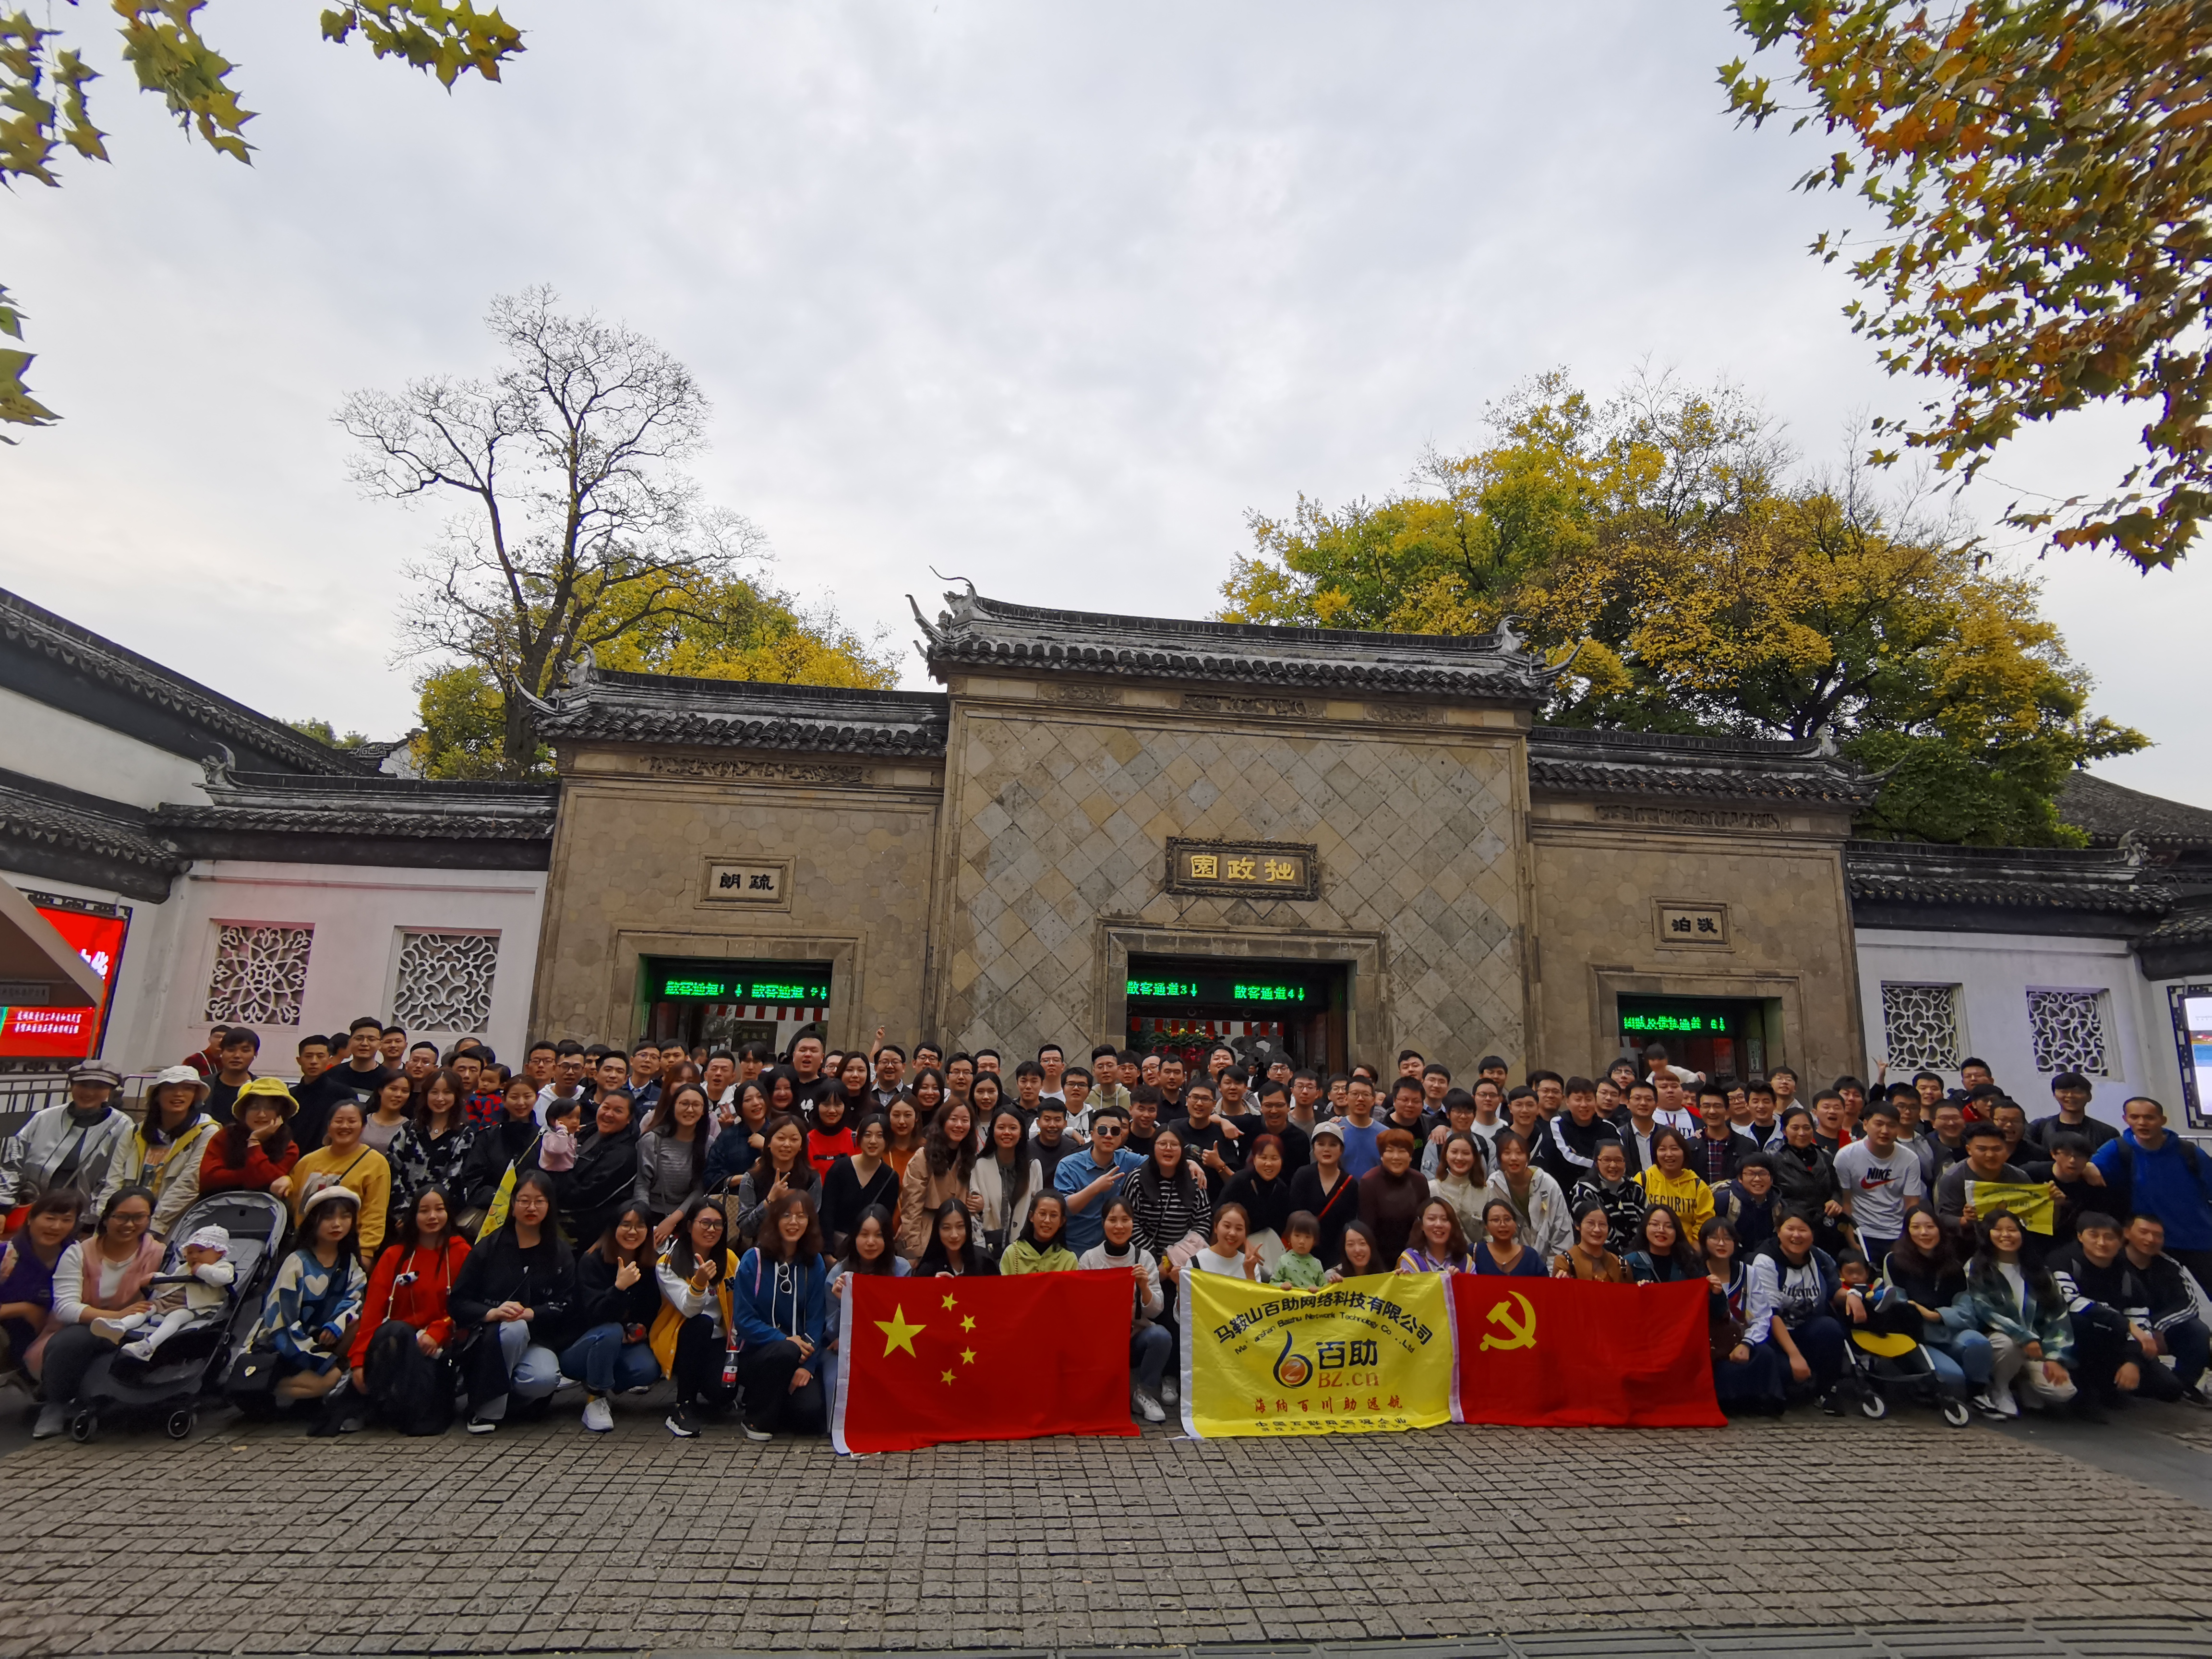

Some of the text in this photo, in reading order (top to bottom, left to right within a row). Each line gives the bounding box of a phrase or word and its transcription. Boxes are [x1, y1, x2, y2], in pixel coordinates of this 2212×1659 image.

[1866, 1167, 1892, 1180] NIKE
[1214, 1290, 1433, 1345] 马鞍山百助网络科技有限公司
[1315, 1338, 1378, 1370] 百助
[1318, 1371, 1379, 1388] BZ.cn
[1255, 1395, 1403, 1414] 海纳百川助远航
